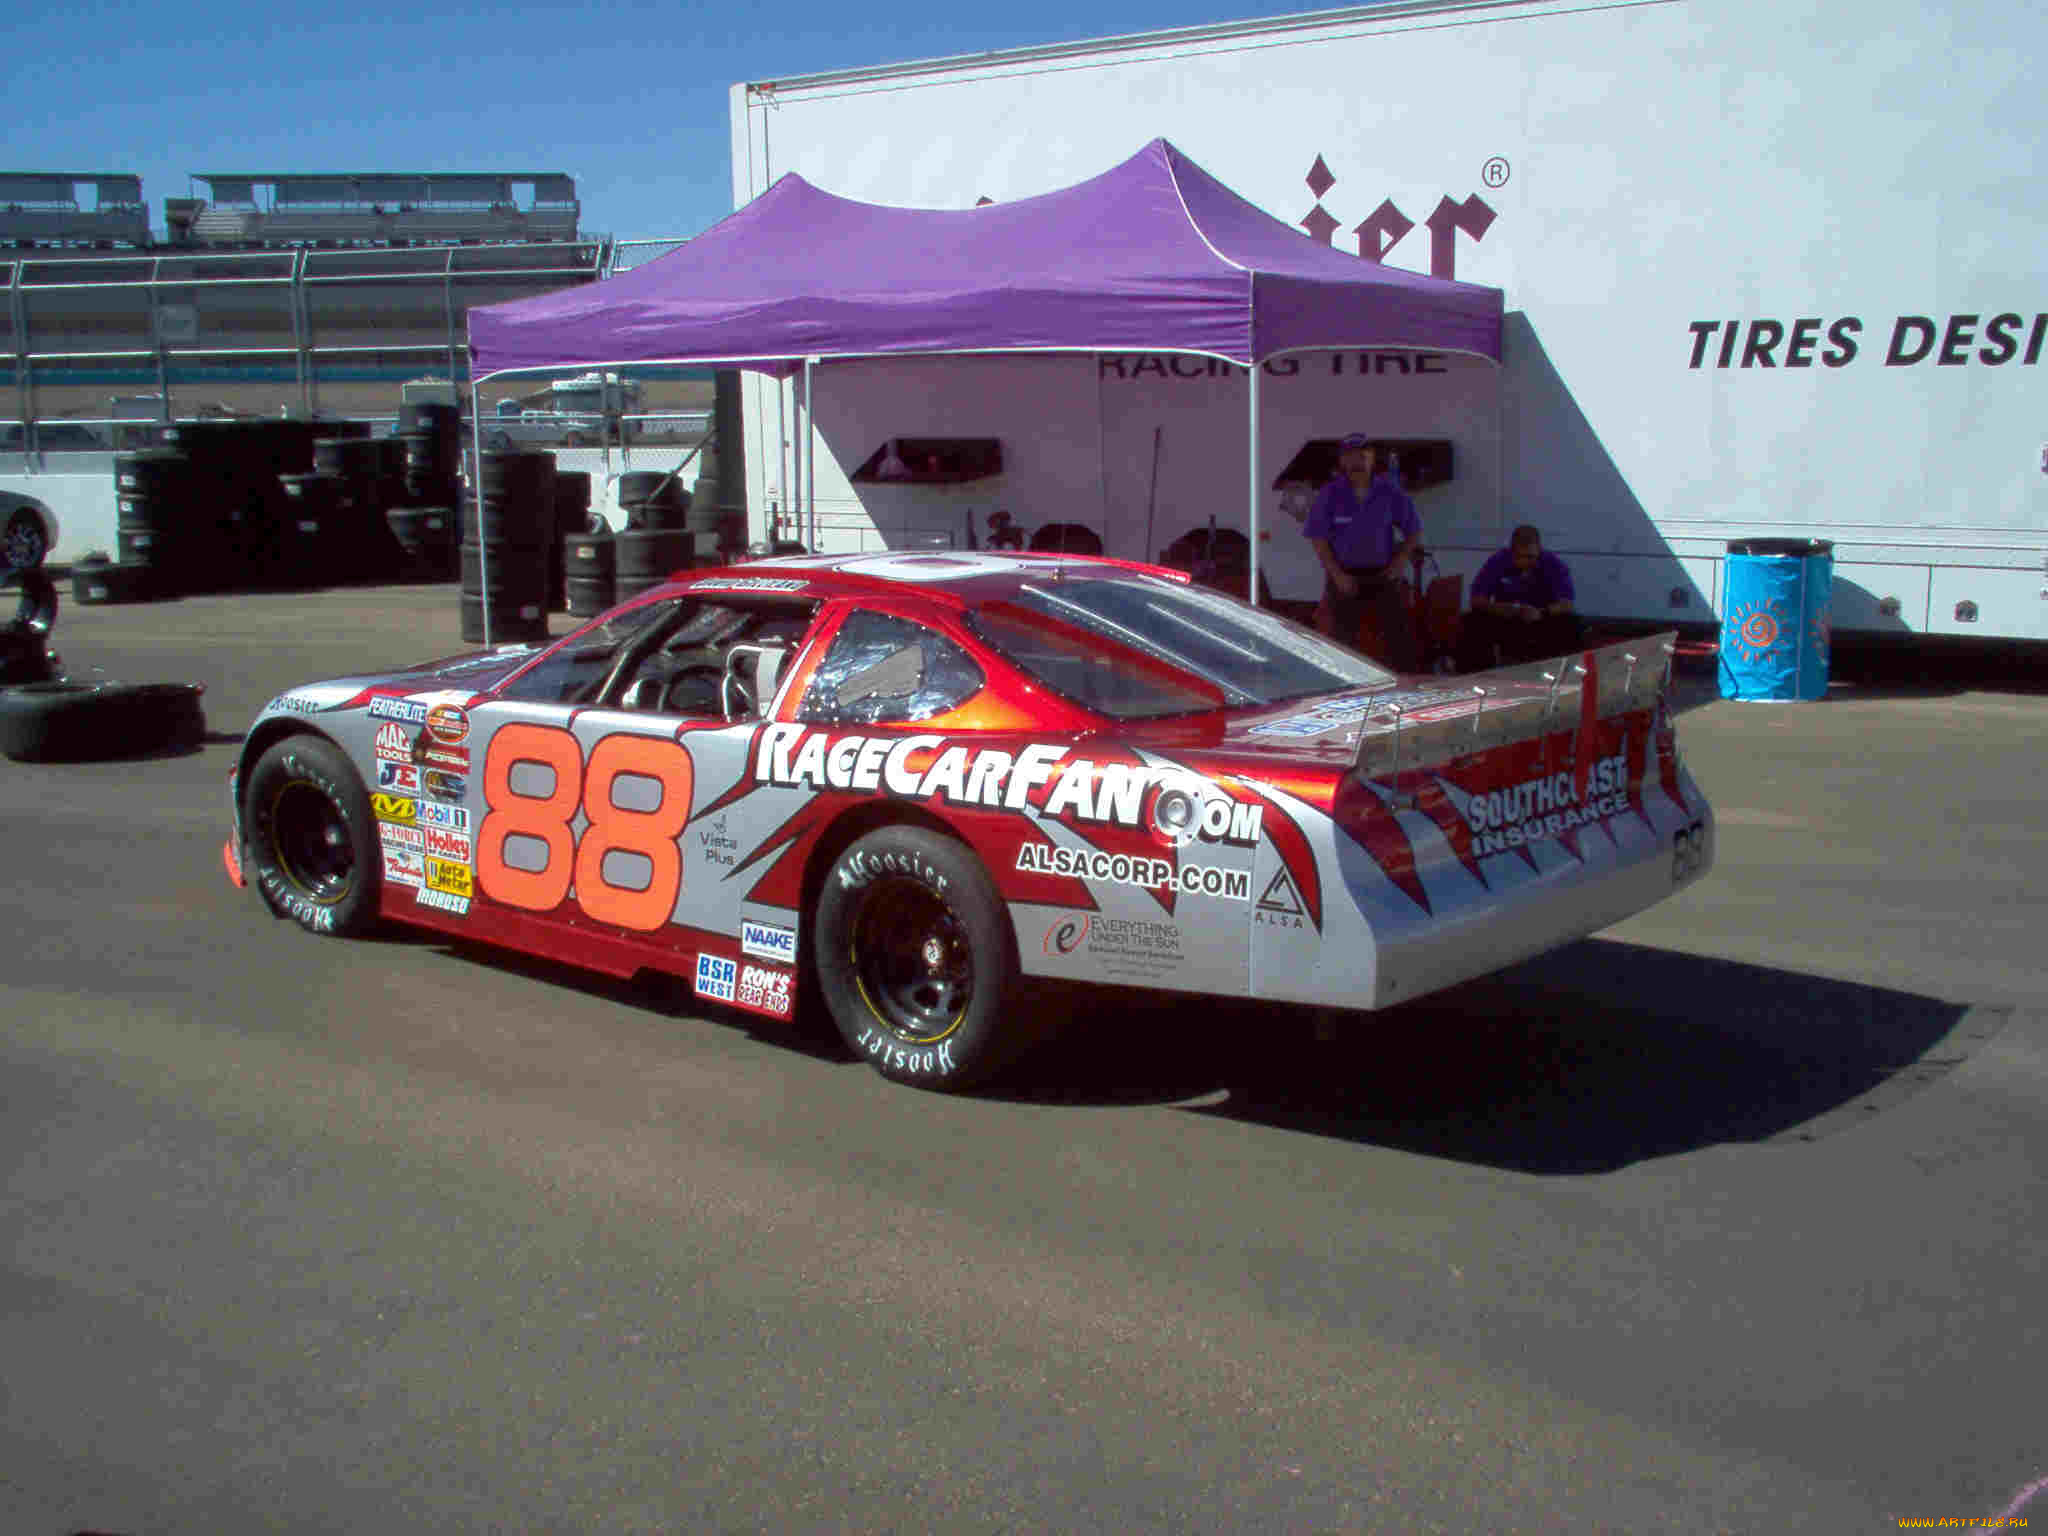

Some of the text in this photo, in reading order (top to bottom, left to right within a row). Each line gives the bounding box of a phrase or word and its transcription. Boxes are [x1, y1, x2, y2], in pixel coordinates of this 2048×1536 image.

[1688, 316, 1863, 369] TIRES
[369, 697, 426, 722] FEATHERLITE
[376, 723, 411, 752] MAC
[377, 748, 412, 762] TOOLS
[476, 721, 696, 932] 88
[1472, 791, 1630, 856] INSURANCE
[425, 827, 469, 861] Holley
[705, 848, 734, 866] Plus
[439, 876, 470, 890] Meter
[440, 864, 465, 878] Auto
[848, 849, 949, 889] Hoosier
[1016, 843, 1250, 900] ALSACORP.COM
[1090, 915, 1179, 937] EVERYTHING
[1255, 911, 1304, 928] ALSA
[744, 926, 793, 950] NAAKE
[698, 955, 735, 984] BSR
[741, 965, 791, 994] RON'S
[697, 975, 733, 1000] WEST
[737, 982, 790, 1014] REAR ENDS
[857, 1026, 957, 1075] Hoosier
